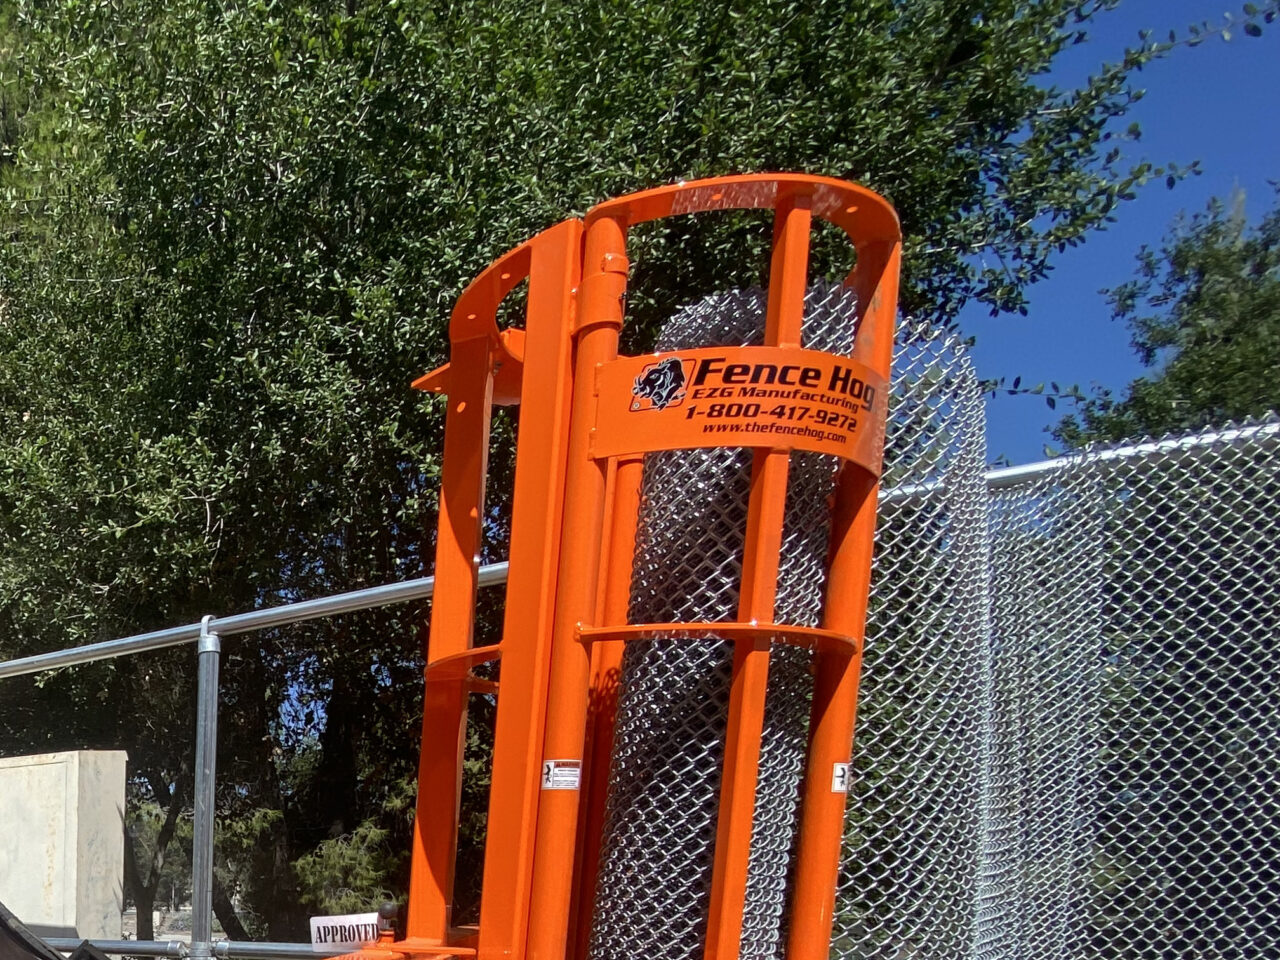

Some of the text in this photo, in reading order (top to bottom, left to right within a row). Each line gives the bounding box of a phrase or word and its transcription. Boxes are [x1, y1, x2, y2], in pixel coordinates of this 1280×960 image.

[692, 357, 876, 411] Fence Hog
[691, 386, 859, 414] EZG Manufacturing
[685, 402, 858, 433] 1-800-417-9272
[702, 421, 847, 444] www.thefencehog.com
[315, 923, 380, 943] APPROVED
